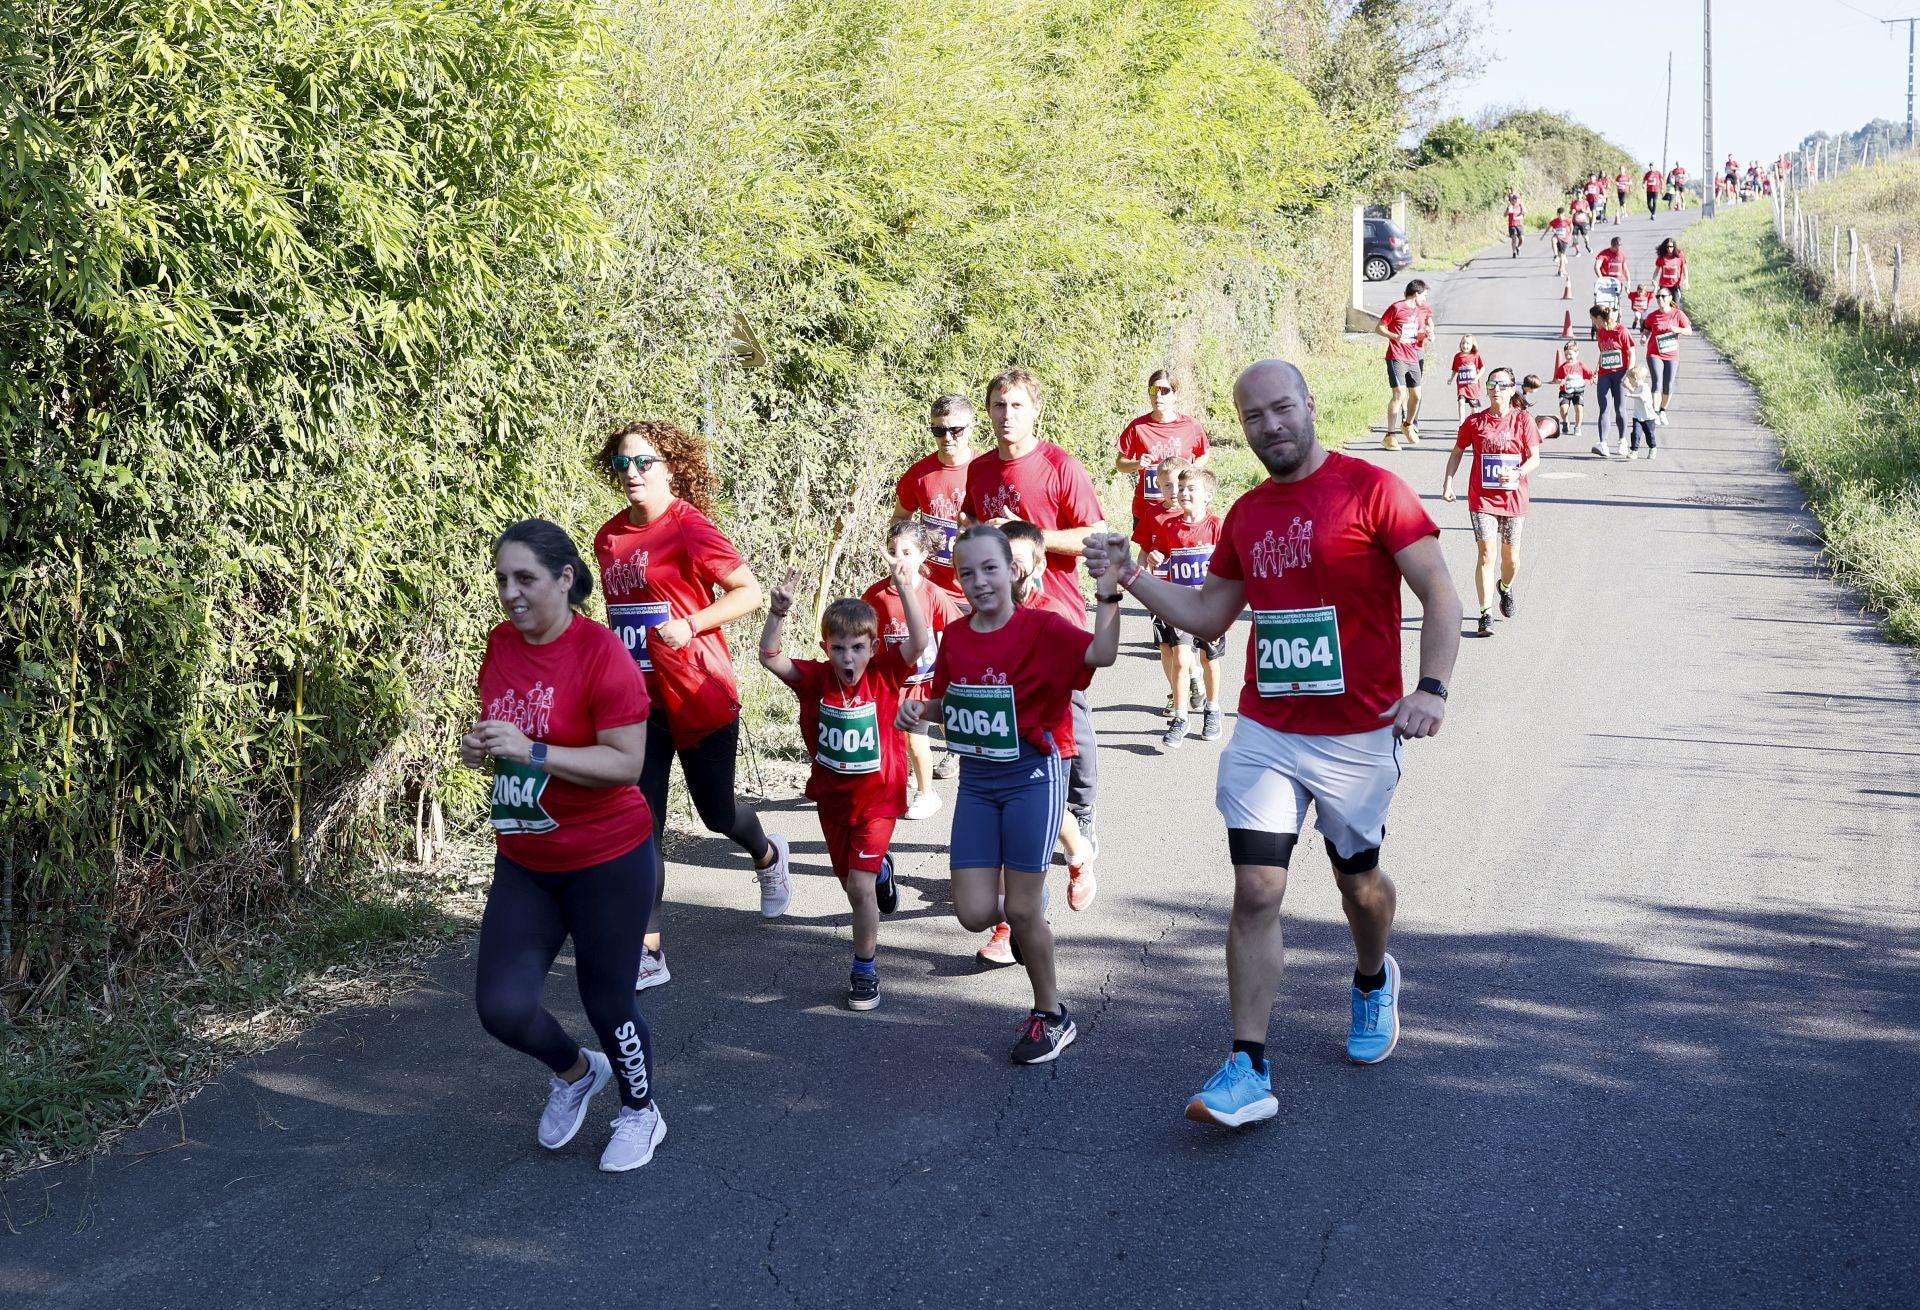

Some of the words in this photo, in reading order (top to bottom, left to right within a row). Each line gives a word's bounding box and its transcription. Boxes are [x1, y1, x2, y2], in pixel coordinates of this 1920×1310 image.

[614, 625, 647, 650] 101
[1258, 636, 1333, 669] 2064
[945, 705, 1010, 737] 2064
[818, 722, 875, 753] 2004
[492, 774, 536, 809] 2064
[614, 1021, 649, 1099] adidas
